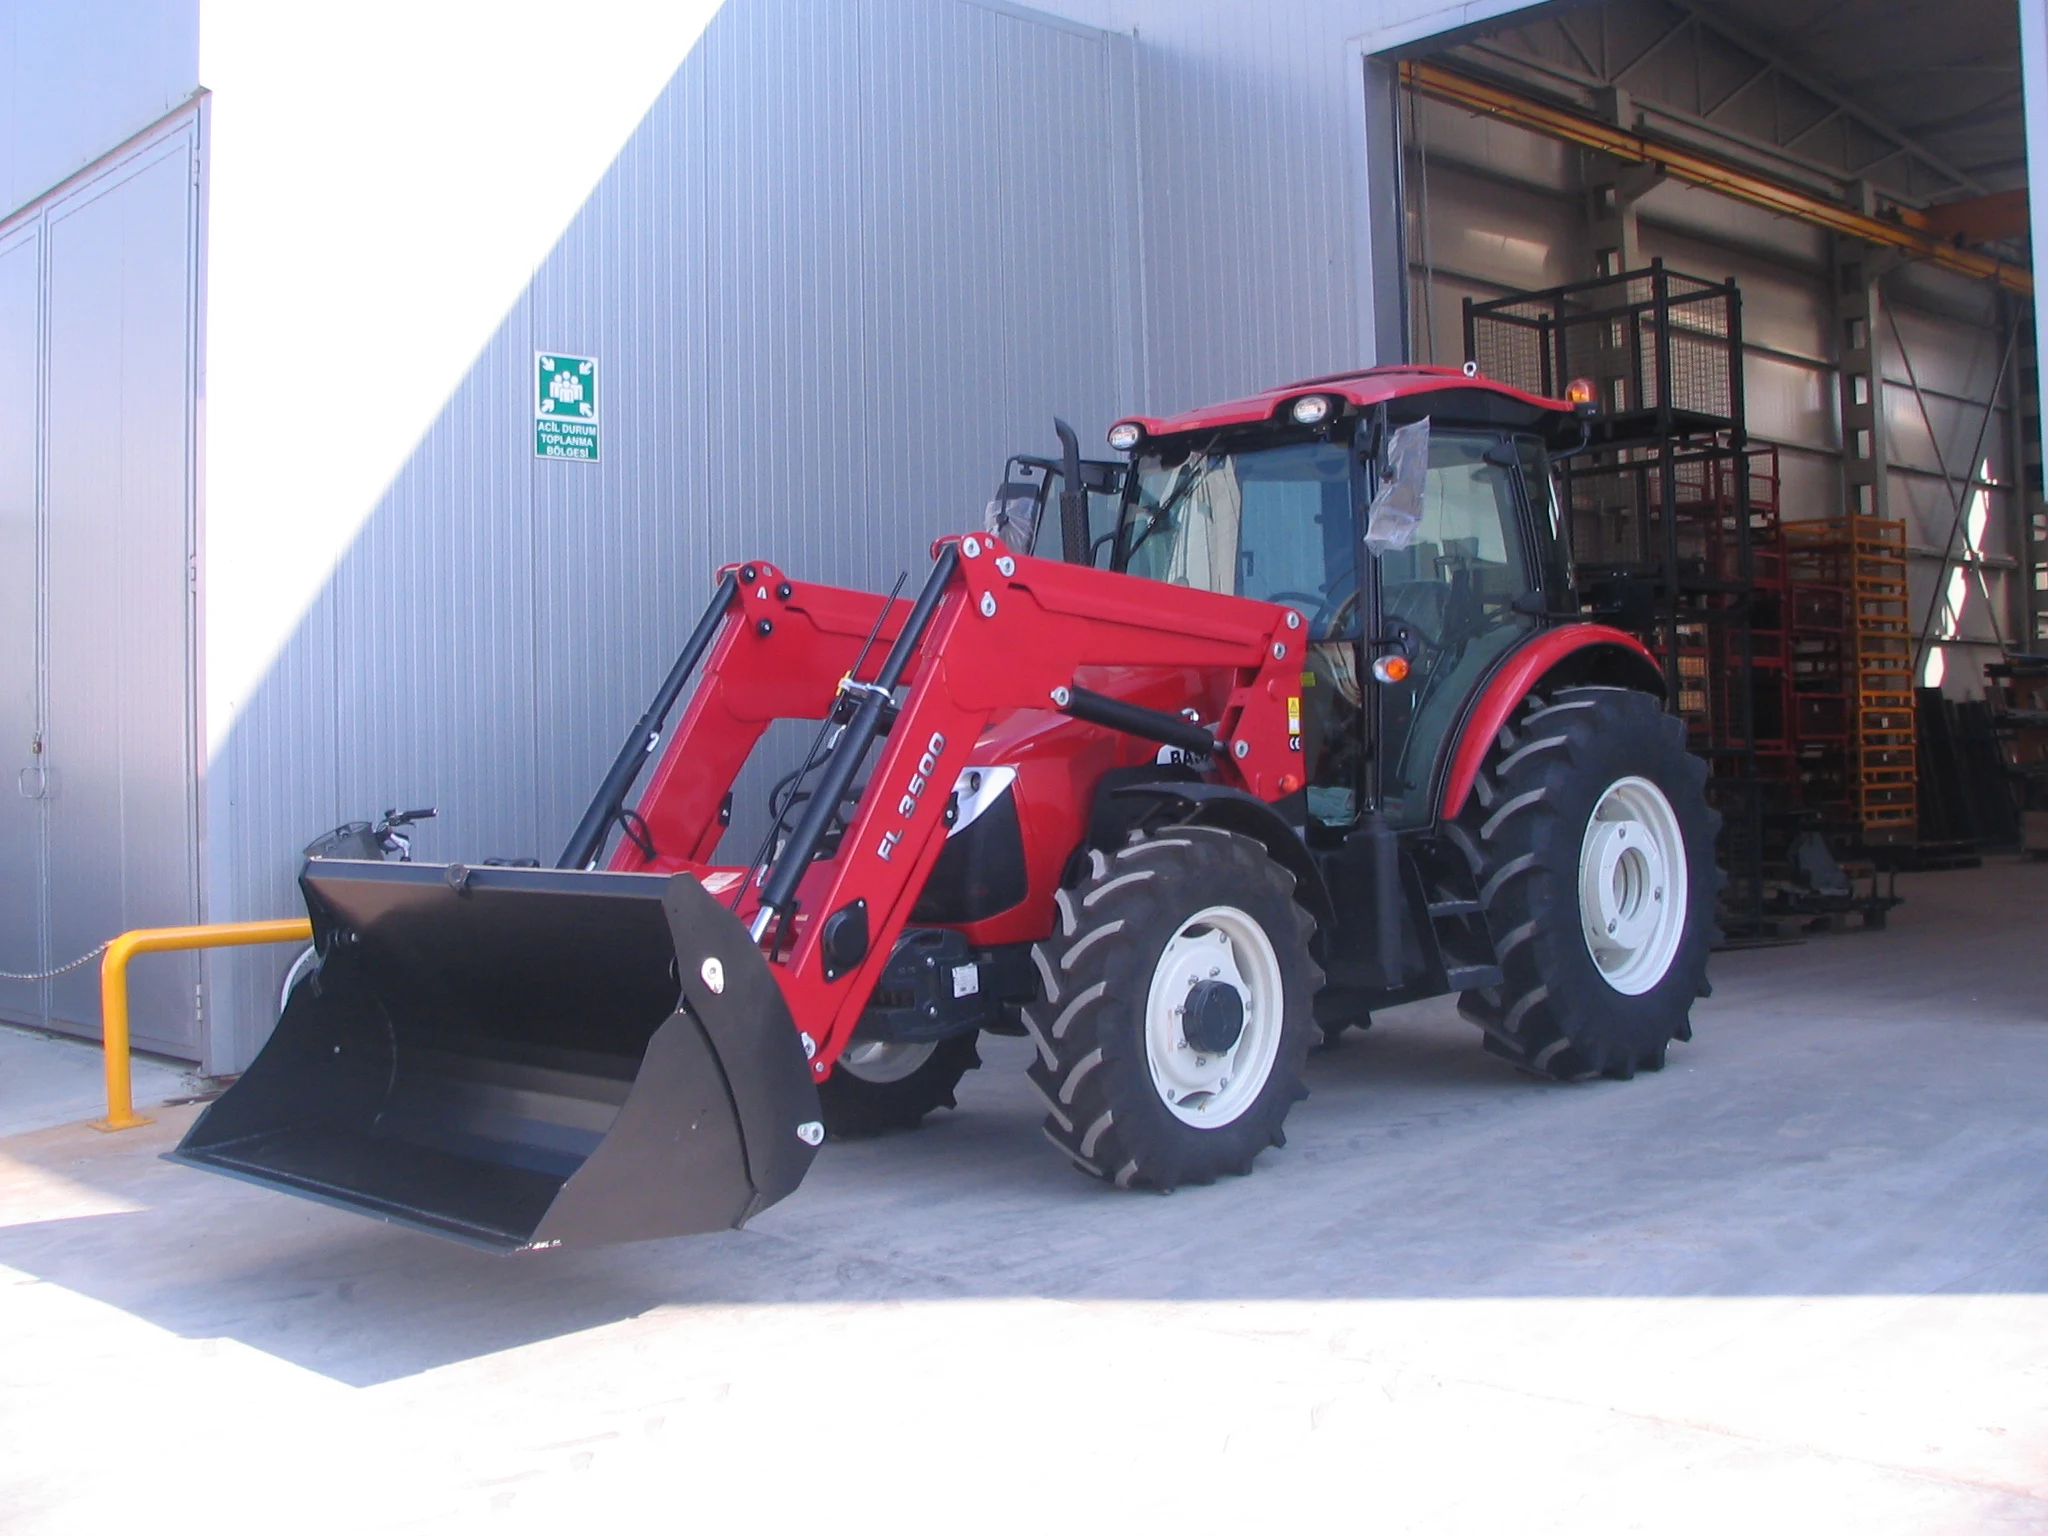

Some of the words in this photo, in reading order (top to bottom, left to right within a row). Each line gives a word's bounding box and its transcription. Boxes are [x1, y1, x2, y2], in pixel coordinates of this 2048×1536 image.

[562, 424, 596, 435] DURUM
[540, 434, 593, 446] TOPLANMA
[877, 829, 903, 861] FL
[898, 732, 946, 819] 3500
